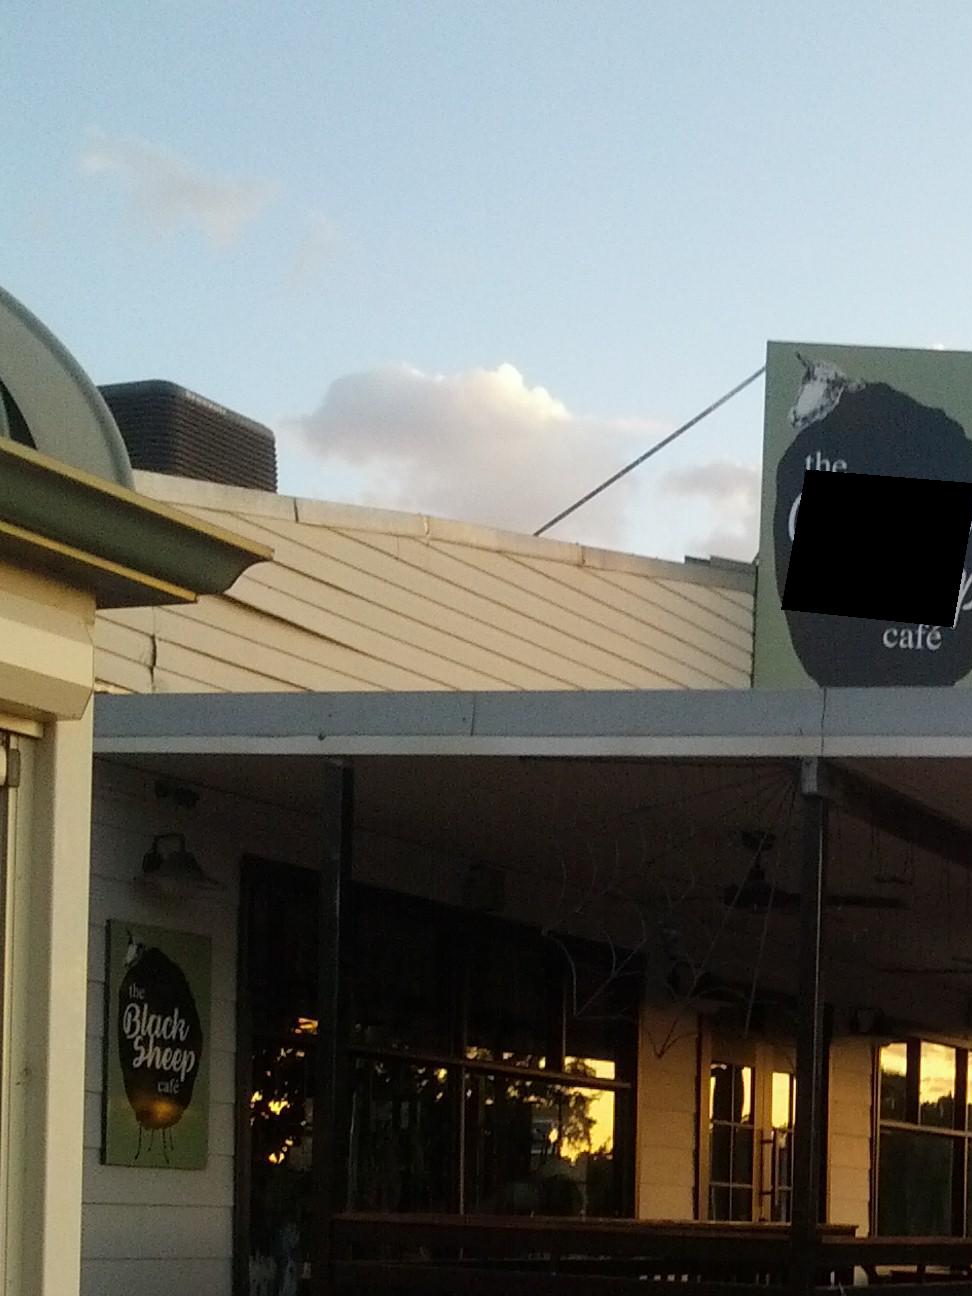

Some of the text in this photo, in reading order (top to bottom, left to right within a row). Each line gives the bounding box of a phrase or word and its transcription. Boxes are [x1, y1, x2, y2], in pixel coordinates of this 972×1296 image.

[129, 983, 146, 1000] the
[123, 1003, 191, 1043] Black
[132, 1035, 196, 1082] Sheep
